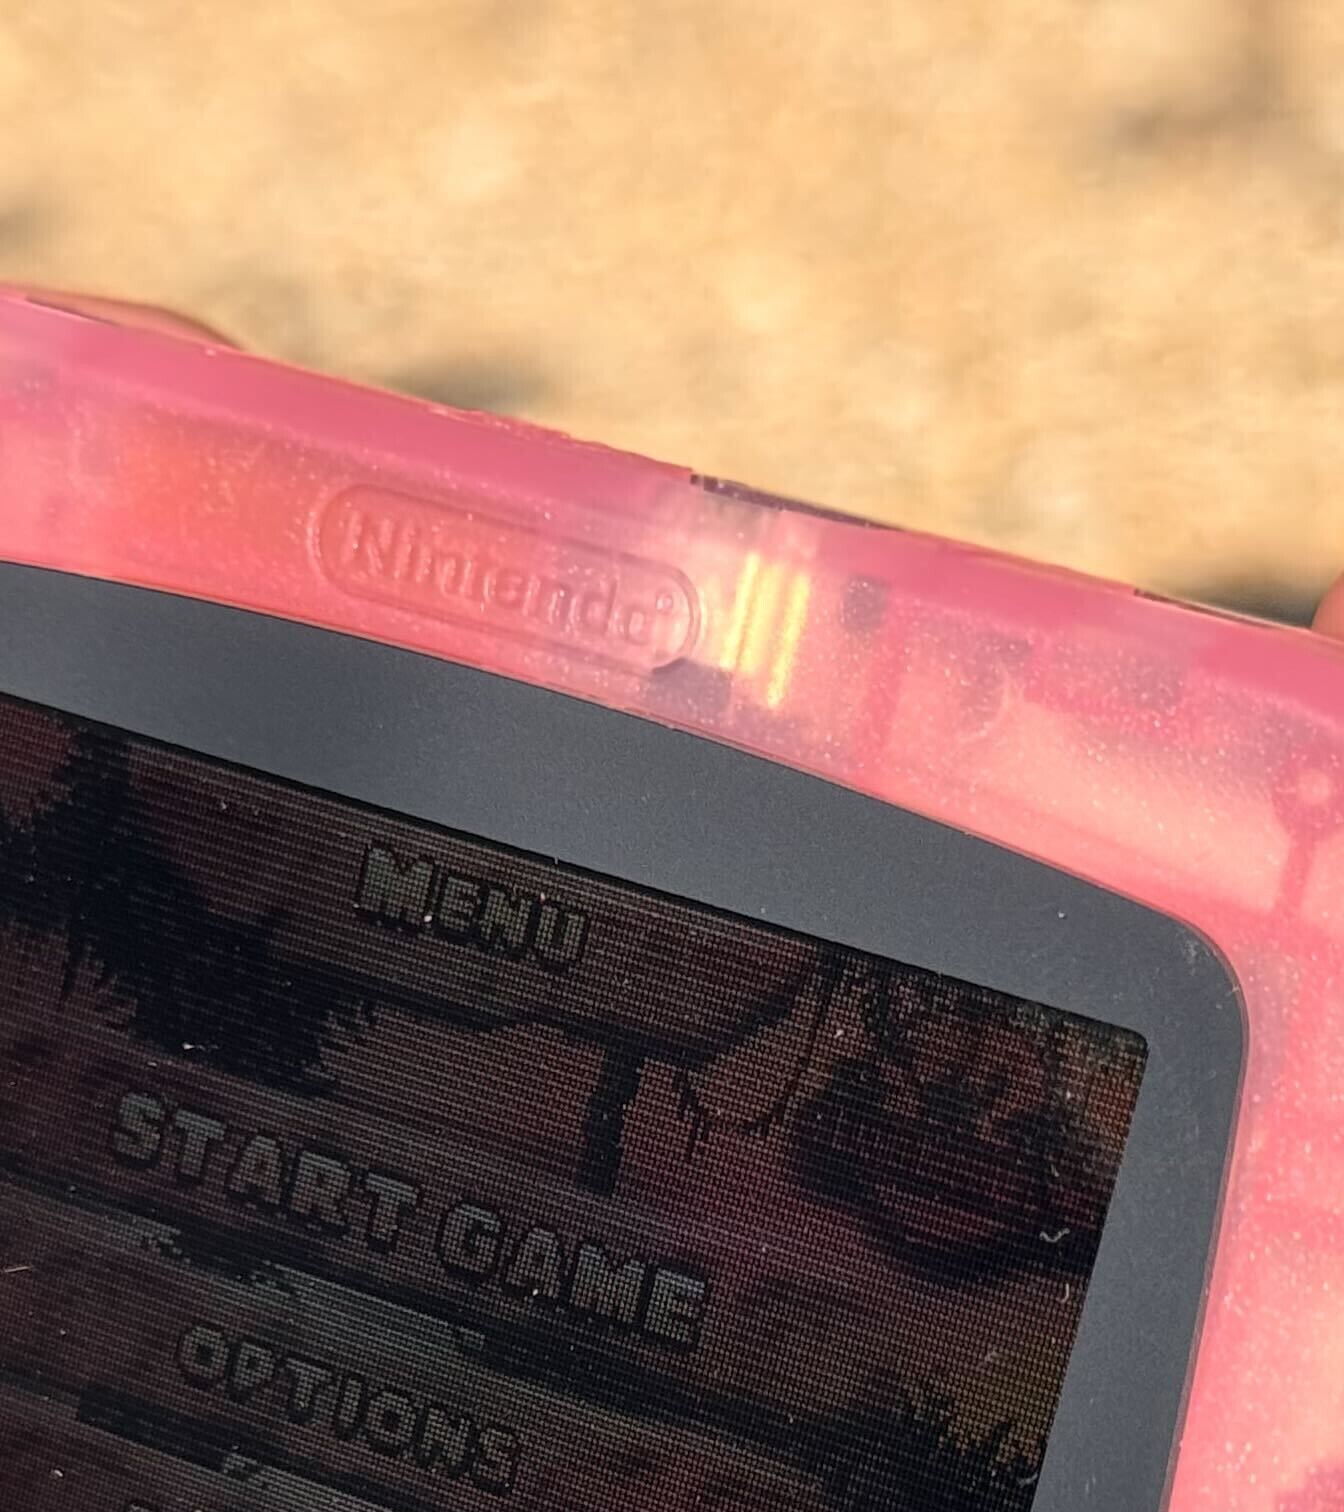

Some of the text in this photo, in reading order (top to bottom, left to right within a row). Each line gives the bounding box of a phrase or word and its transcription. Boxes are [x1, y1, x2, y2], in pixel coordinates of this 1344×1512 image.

[358, 845, 589, 964] MENU
[113, 1090, 709, 1350] START GAME
[179, 1323, 517, 1492] OPTIONS
